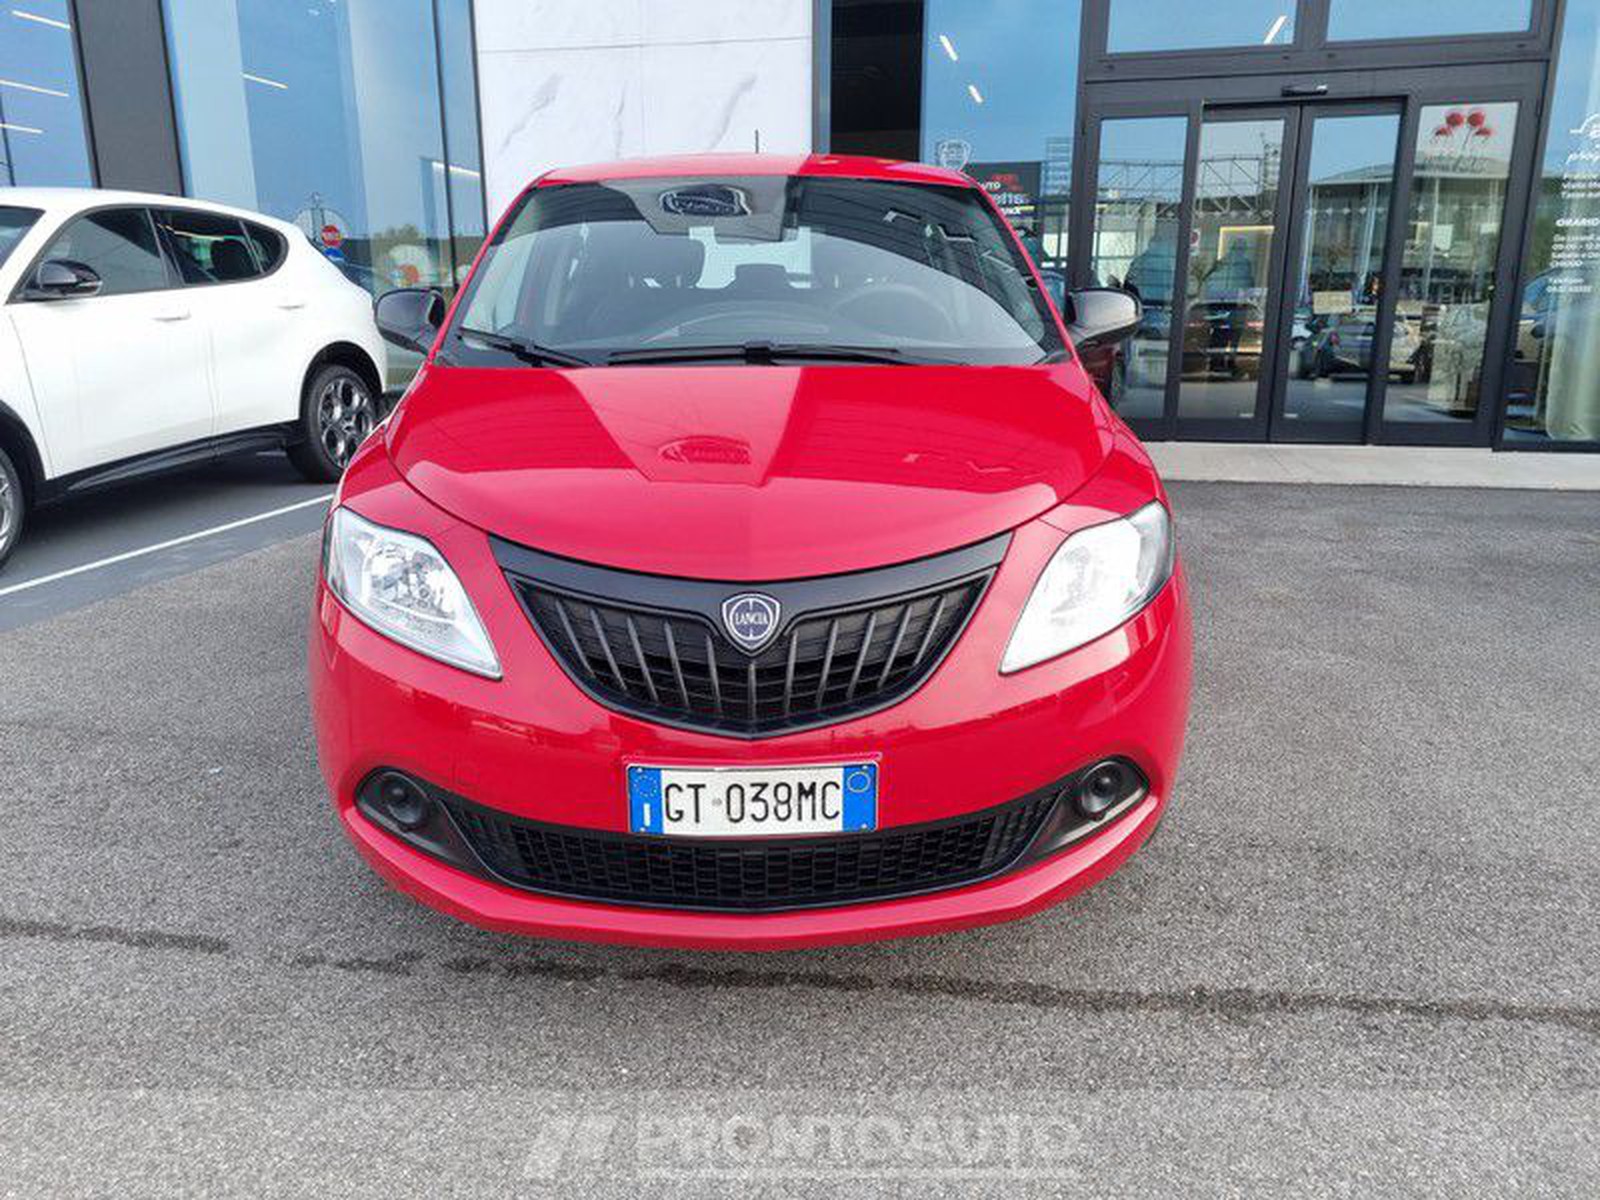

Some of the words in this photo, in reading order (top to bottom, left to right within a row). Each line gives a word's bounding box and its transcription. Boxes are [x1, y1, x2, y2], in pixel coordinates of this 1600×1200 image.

[735, 611, 769, 626] LANCIA
[664, 783, 706, 823] GT
[726, 780, 840, 823] 038MC
